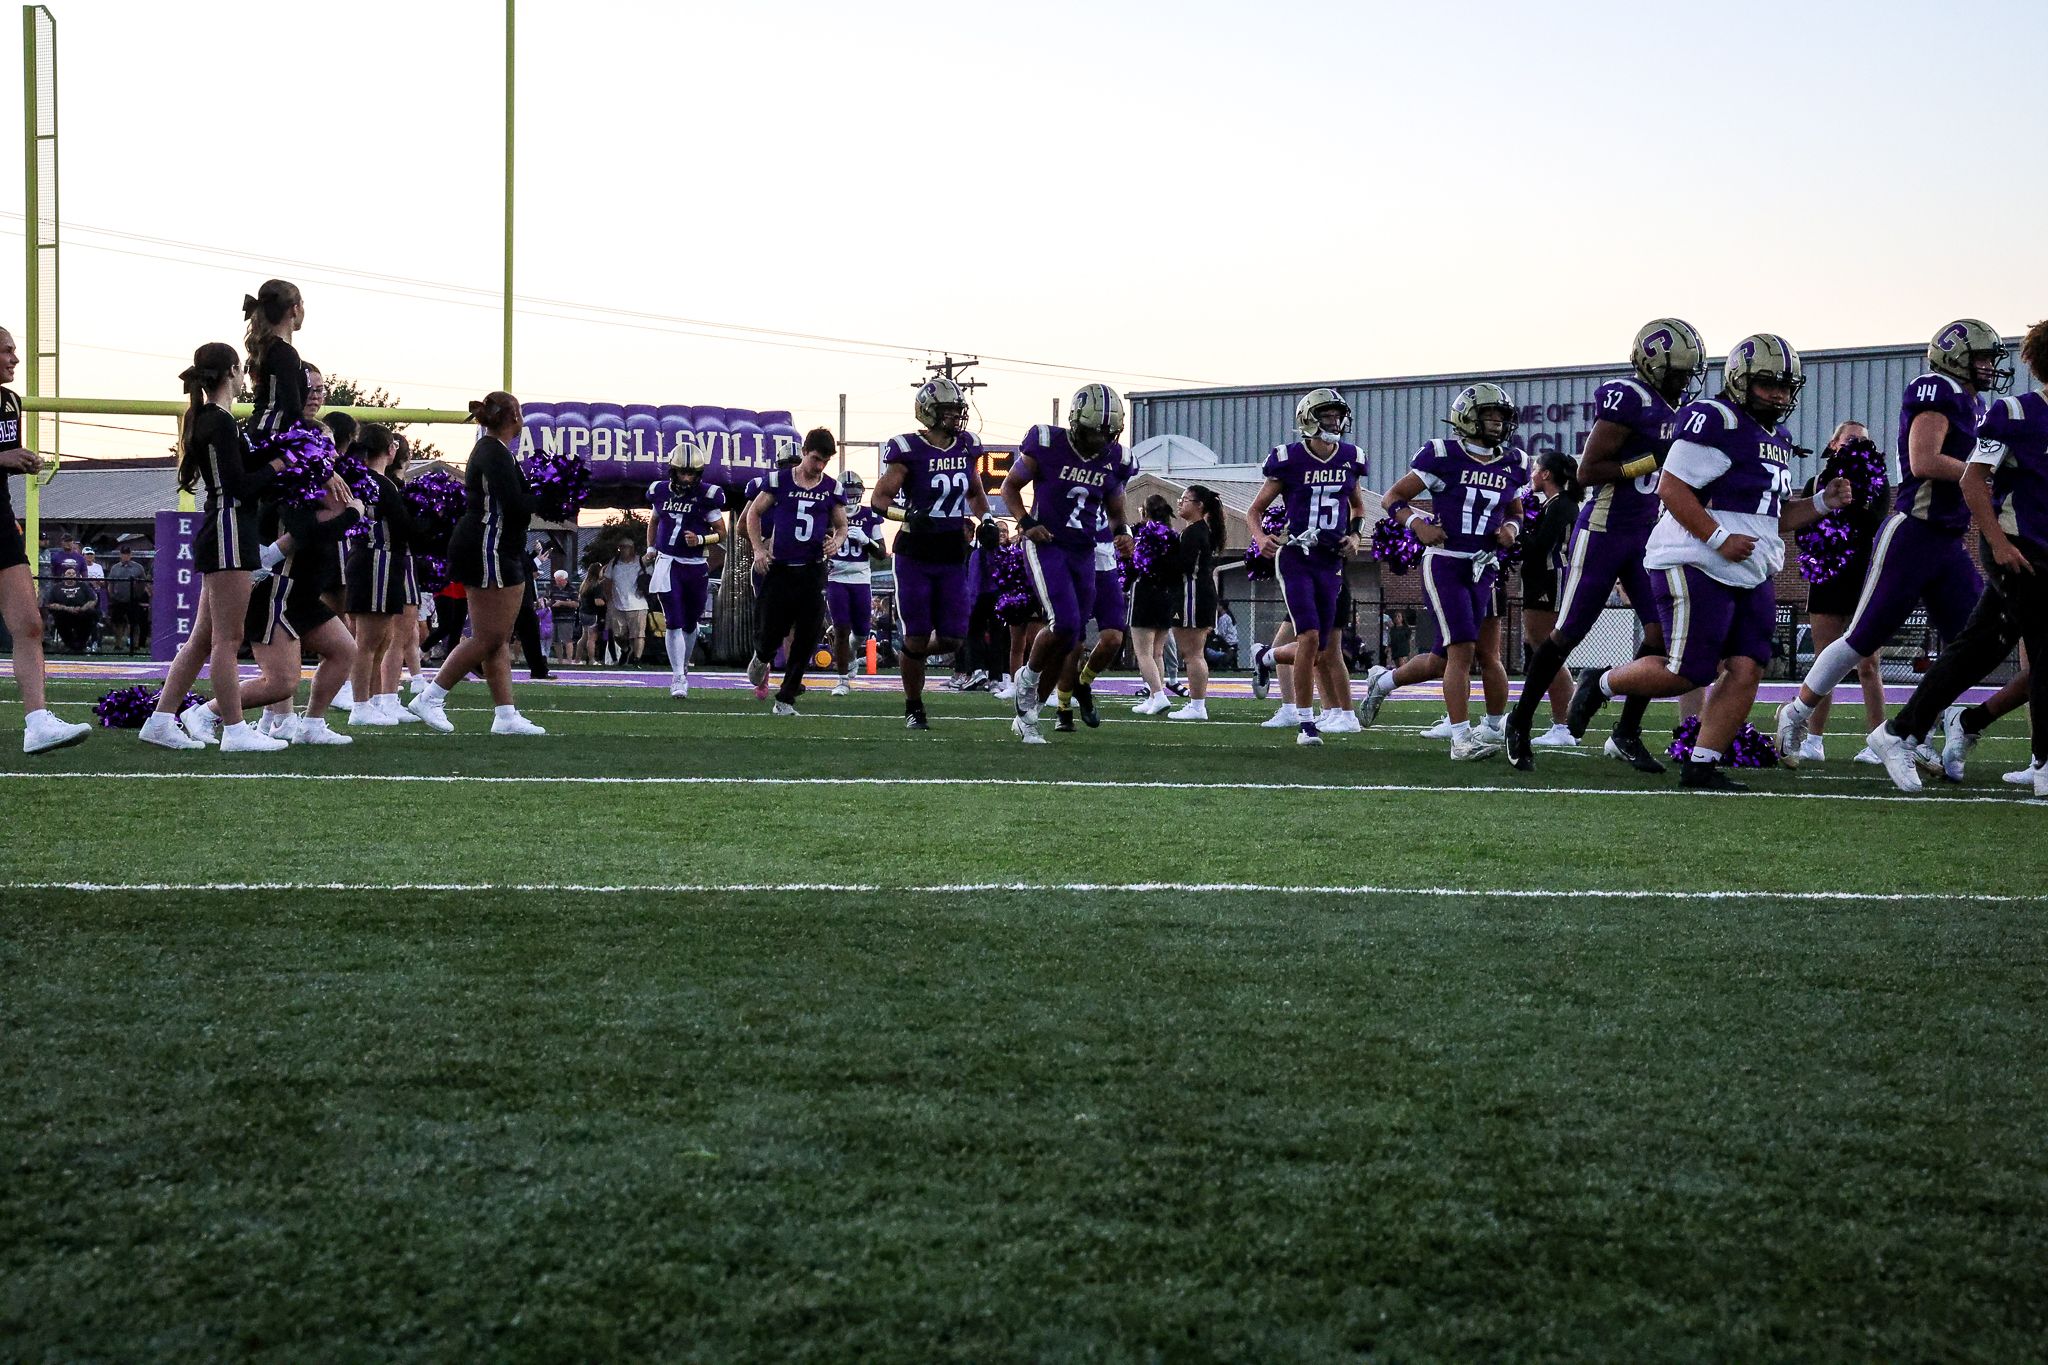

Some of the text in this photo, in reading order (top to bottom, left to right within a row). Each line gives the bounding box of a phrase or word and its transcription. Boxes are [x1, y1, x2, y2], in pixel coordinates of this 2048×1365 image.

[1603, 389, 1624, 411] 32
[1916, 384, 1937, 402] 44
[1546, 403, 1575, 423] OF
[1683, 410, 1706, 434] 78
[928, 456, 967, 472] EAGLES
[1059, 465, 1107, 487] EAGLES
[1303, 469, 1346, 485] EAGLES
[1459, 470, 1507, 490] EAGLES
[928, 472, 969, 518] 22
[662, 501, 694, 513] EAGLES
[1065, 486, 1089, 529] 2
[1307, 485, 1342, 530] 15
[1461, 486, 1500, 536] 17
[668, 513, 684, 546] 7
[794, 500, 815, 542] 5
[176, 518, 193, 653] EAGLE
